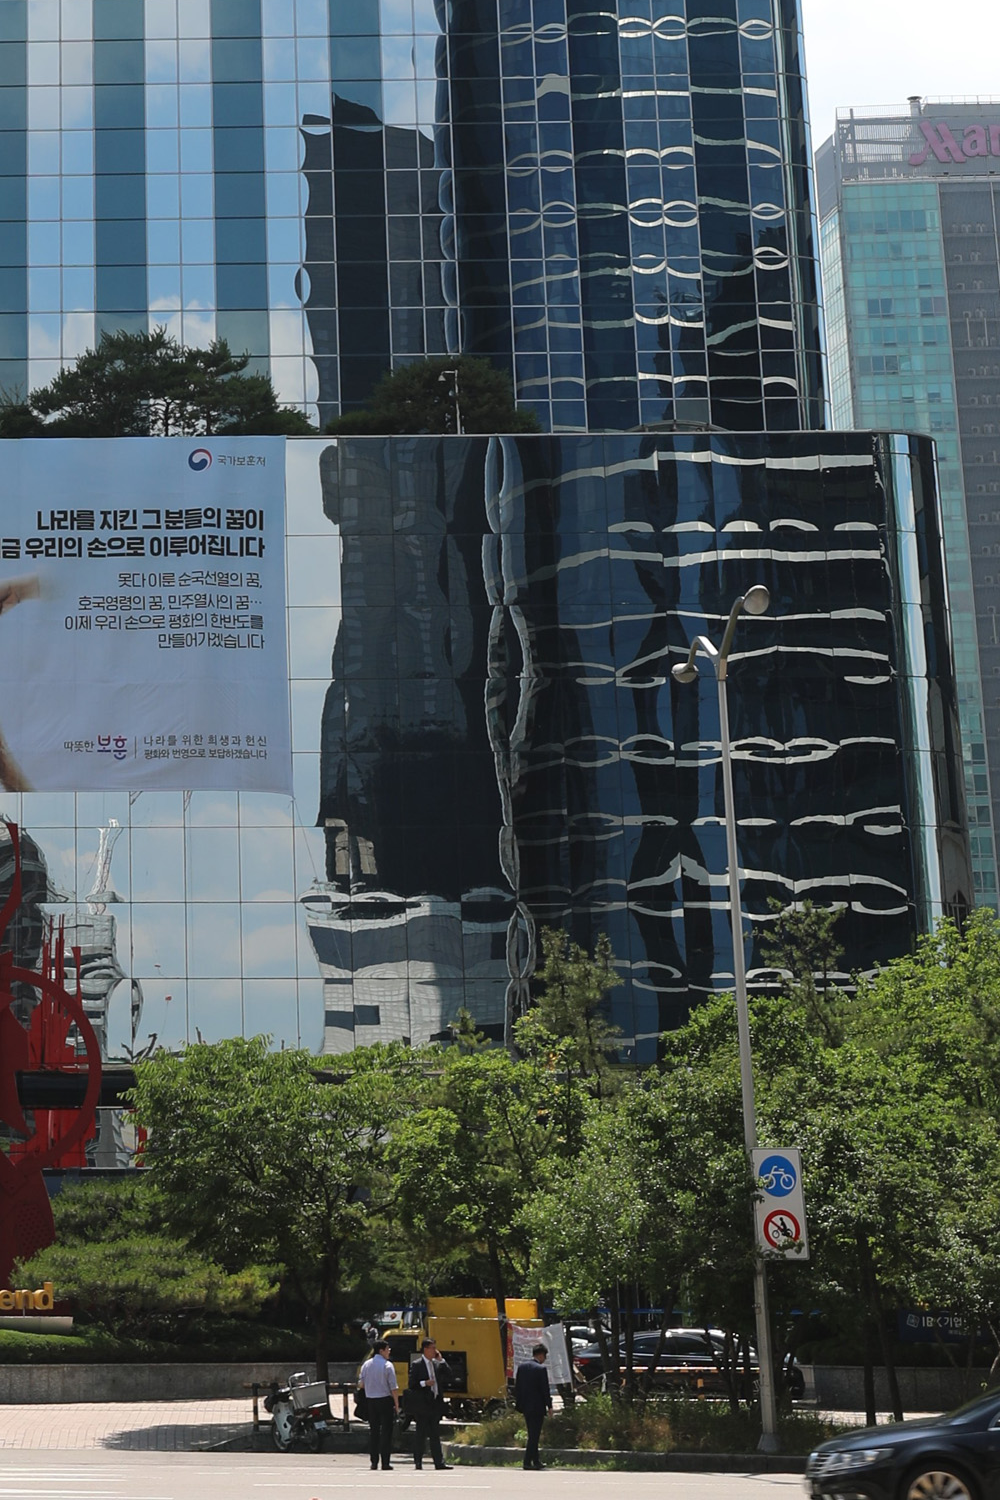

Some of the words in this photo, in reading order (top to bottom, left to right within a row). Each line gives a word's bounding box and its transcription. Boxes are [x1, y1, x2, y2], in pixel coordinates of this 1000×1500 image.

[218, 455, 265, 466] 국가보훈처
[36, 509, 95, 531] 나라를
[99, 509, 137, 530] 지킨
[226, 508, 264, 530] 꿈이
[25, 536, 82, 558] 우리의
[87, 536, 145, 558] 손으로
[150, 535, 265, 558] 이루어집니다
[118, 573, 145, 588] 못다
[148, 572, 175, 588] 이룬
[178, 571, 242, 587] 순국선열의
[246, 573, 263, 589] 꿈,
[78, 595, 145, 611] 호국영령의
[149, 595, 165, 611] 꿈,
[168, 594, 232, 611] 민주열사의
[65, 615, 91, 631] 이제
[95, 615, 121, 631] 우리
[125, 615, 165, 630] 손으로
[168, 614, 207, 630] 평화의
[211, 614, 264, 630] 한반도를
[158, 632, 265, 649] 만들어가겠습니다
[64, 740, 94, 753] 따뜻한
[97, 735, 127, 760] 보훈
[144, 736, 177, 746] 나라를
[182, 735, 203, 746] 위한
[208, 735, 241, 746] 희생과
[245, 735, 267, 747] 헌신
[144, 749, 169, 760] 평화와
[172, 749, 206, 759] 번영으로
[209, 749, 267, 760] 보답하겠습니다
